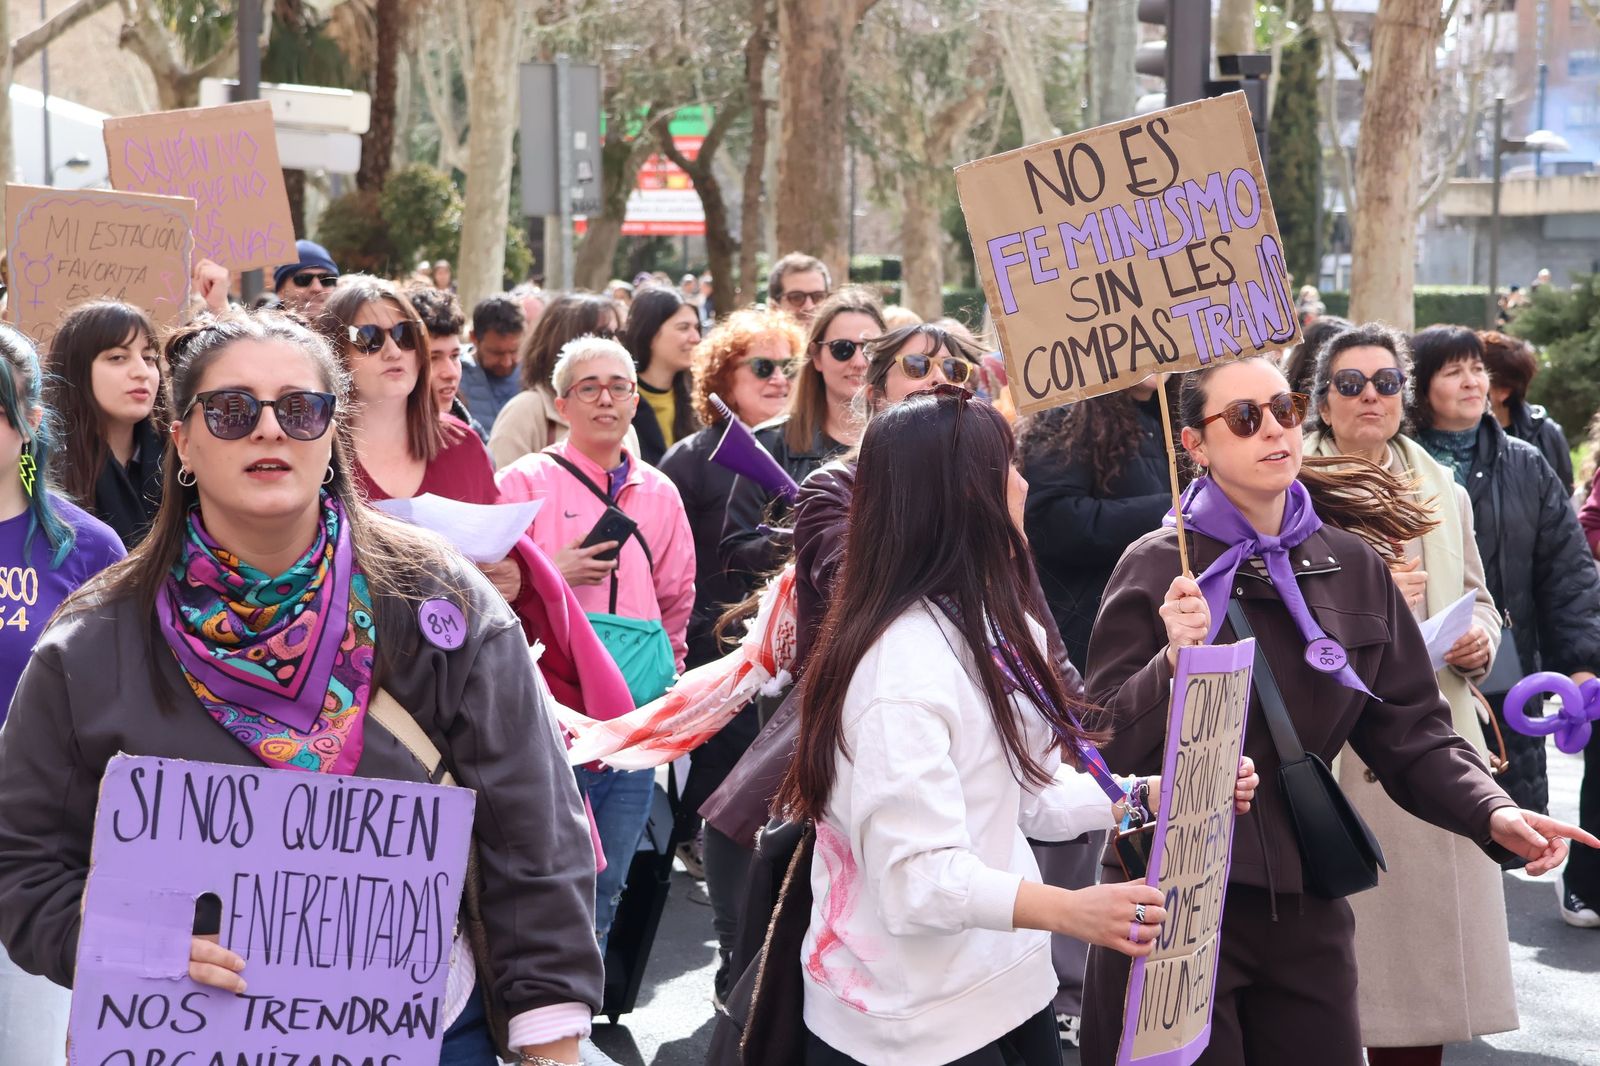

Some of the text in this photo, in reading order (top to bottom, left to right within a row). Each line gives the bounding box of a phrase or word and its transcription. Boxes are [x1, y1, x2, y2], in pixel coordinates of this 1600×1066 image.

[215, 129, 260, 168] NO
[1023, 117, 1180, 216] NO ES
[44, 215, 185, 254] MI ESTACIÓN
[57, 258, 150, 286] FAVORITA
[66, 283, 90, 301] ES
[1065, 235, 1237, 323] SIN LES
[1023, 234, 1297, 400] COMPAS TRANS
[427, 612, 459, 635] 8M
[1319, 646, 1335, 666] 8M
[179, 772, 259, 848] NOS
[282, 777, 440, 861] QUIEREN
[227, 871, 450, 985] ENFRENTADAS
[98, 991, 439, 1039] NOS TRENDRÁN
